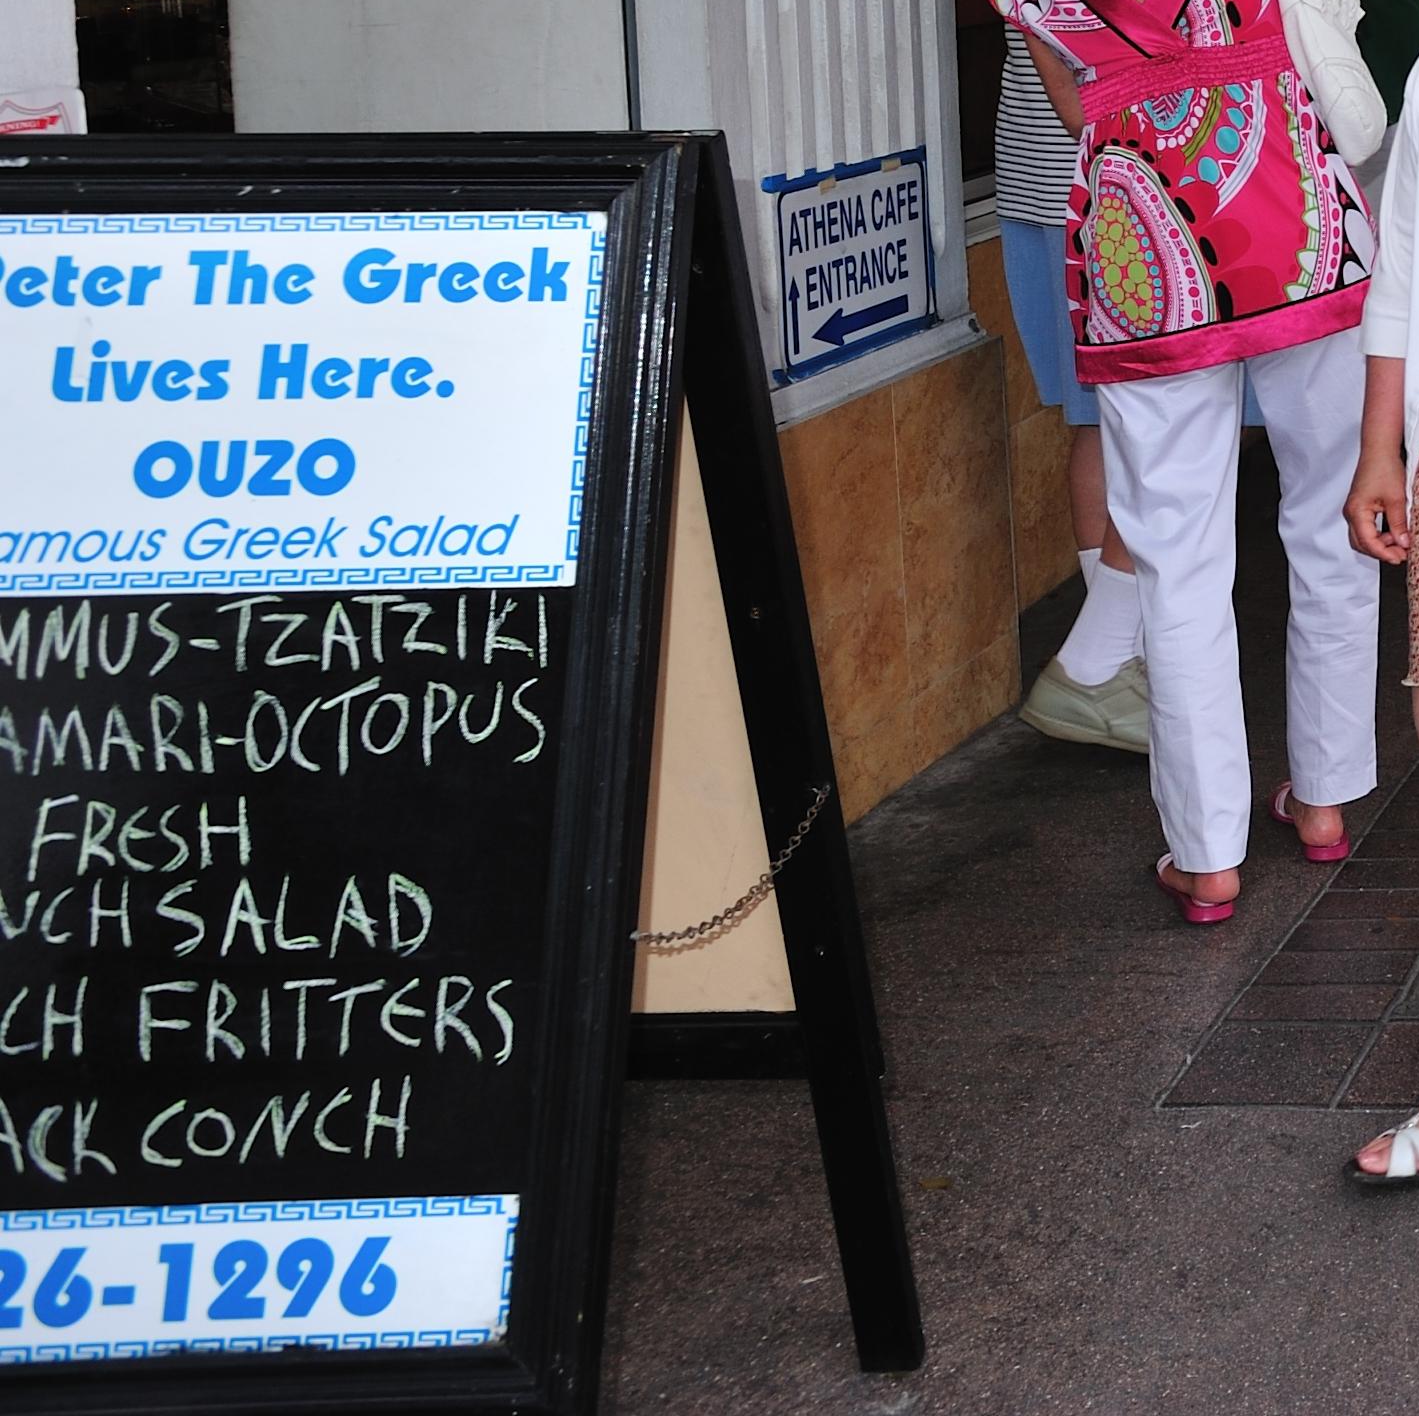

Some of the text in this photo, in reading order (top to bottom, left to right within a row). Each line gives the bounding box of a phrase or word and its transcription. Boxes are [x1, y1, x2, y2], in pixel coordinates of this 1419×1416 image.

[789, 180, 919, 256] ATHENA CAFE
[188, 249, 314, 306] The
[343, 248, 569, 306] Greek
[806, 238, 909, 311] ENTRANCE
[52, 340, 456, 403] Lives Here.
[133, 438, 356, 499] OUZO
[0, 514, 520, 565] amous Greek Salad
[0, 591, 549, 681] MMUS-TZATZIKI
[0, 678, 547, 775] AMARI-OCTOPUS
[29, 794, 252, 880] FRESH
[0, 874, 432, 958] NCH SALAD
[0, 974, 516, 1067] CH FRITTERS
[140, 1075, 411, 1168] CONCH
